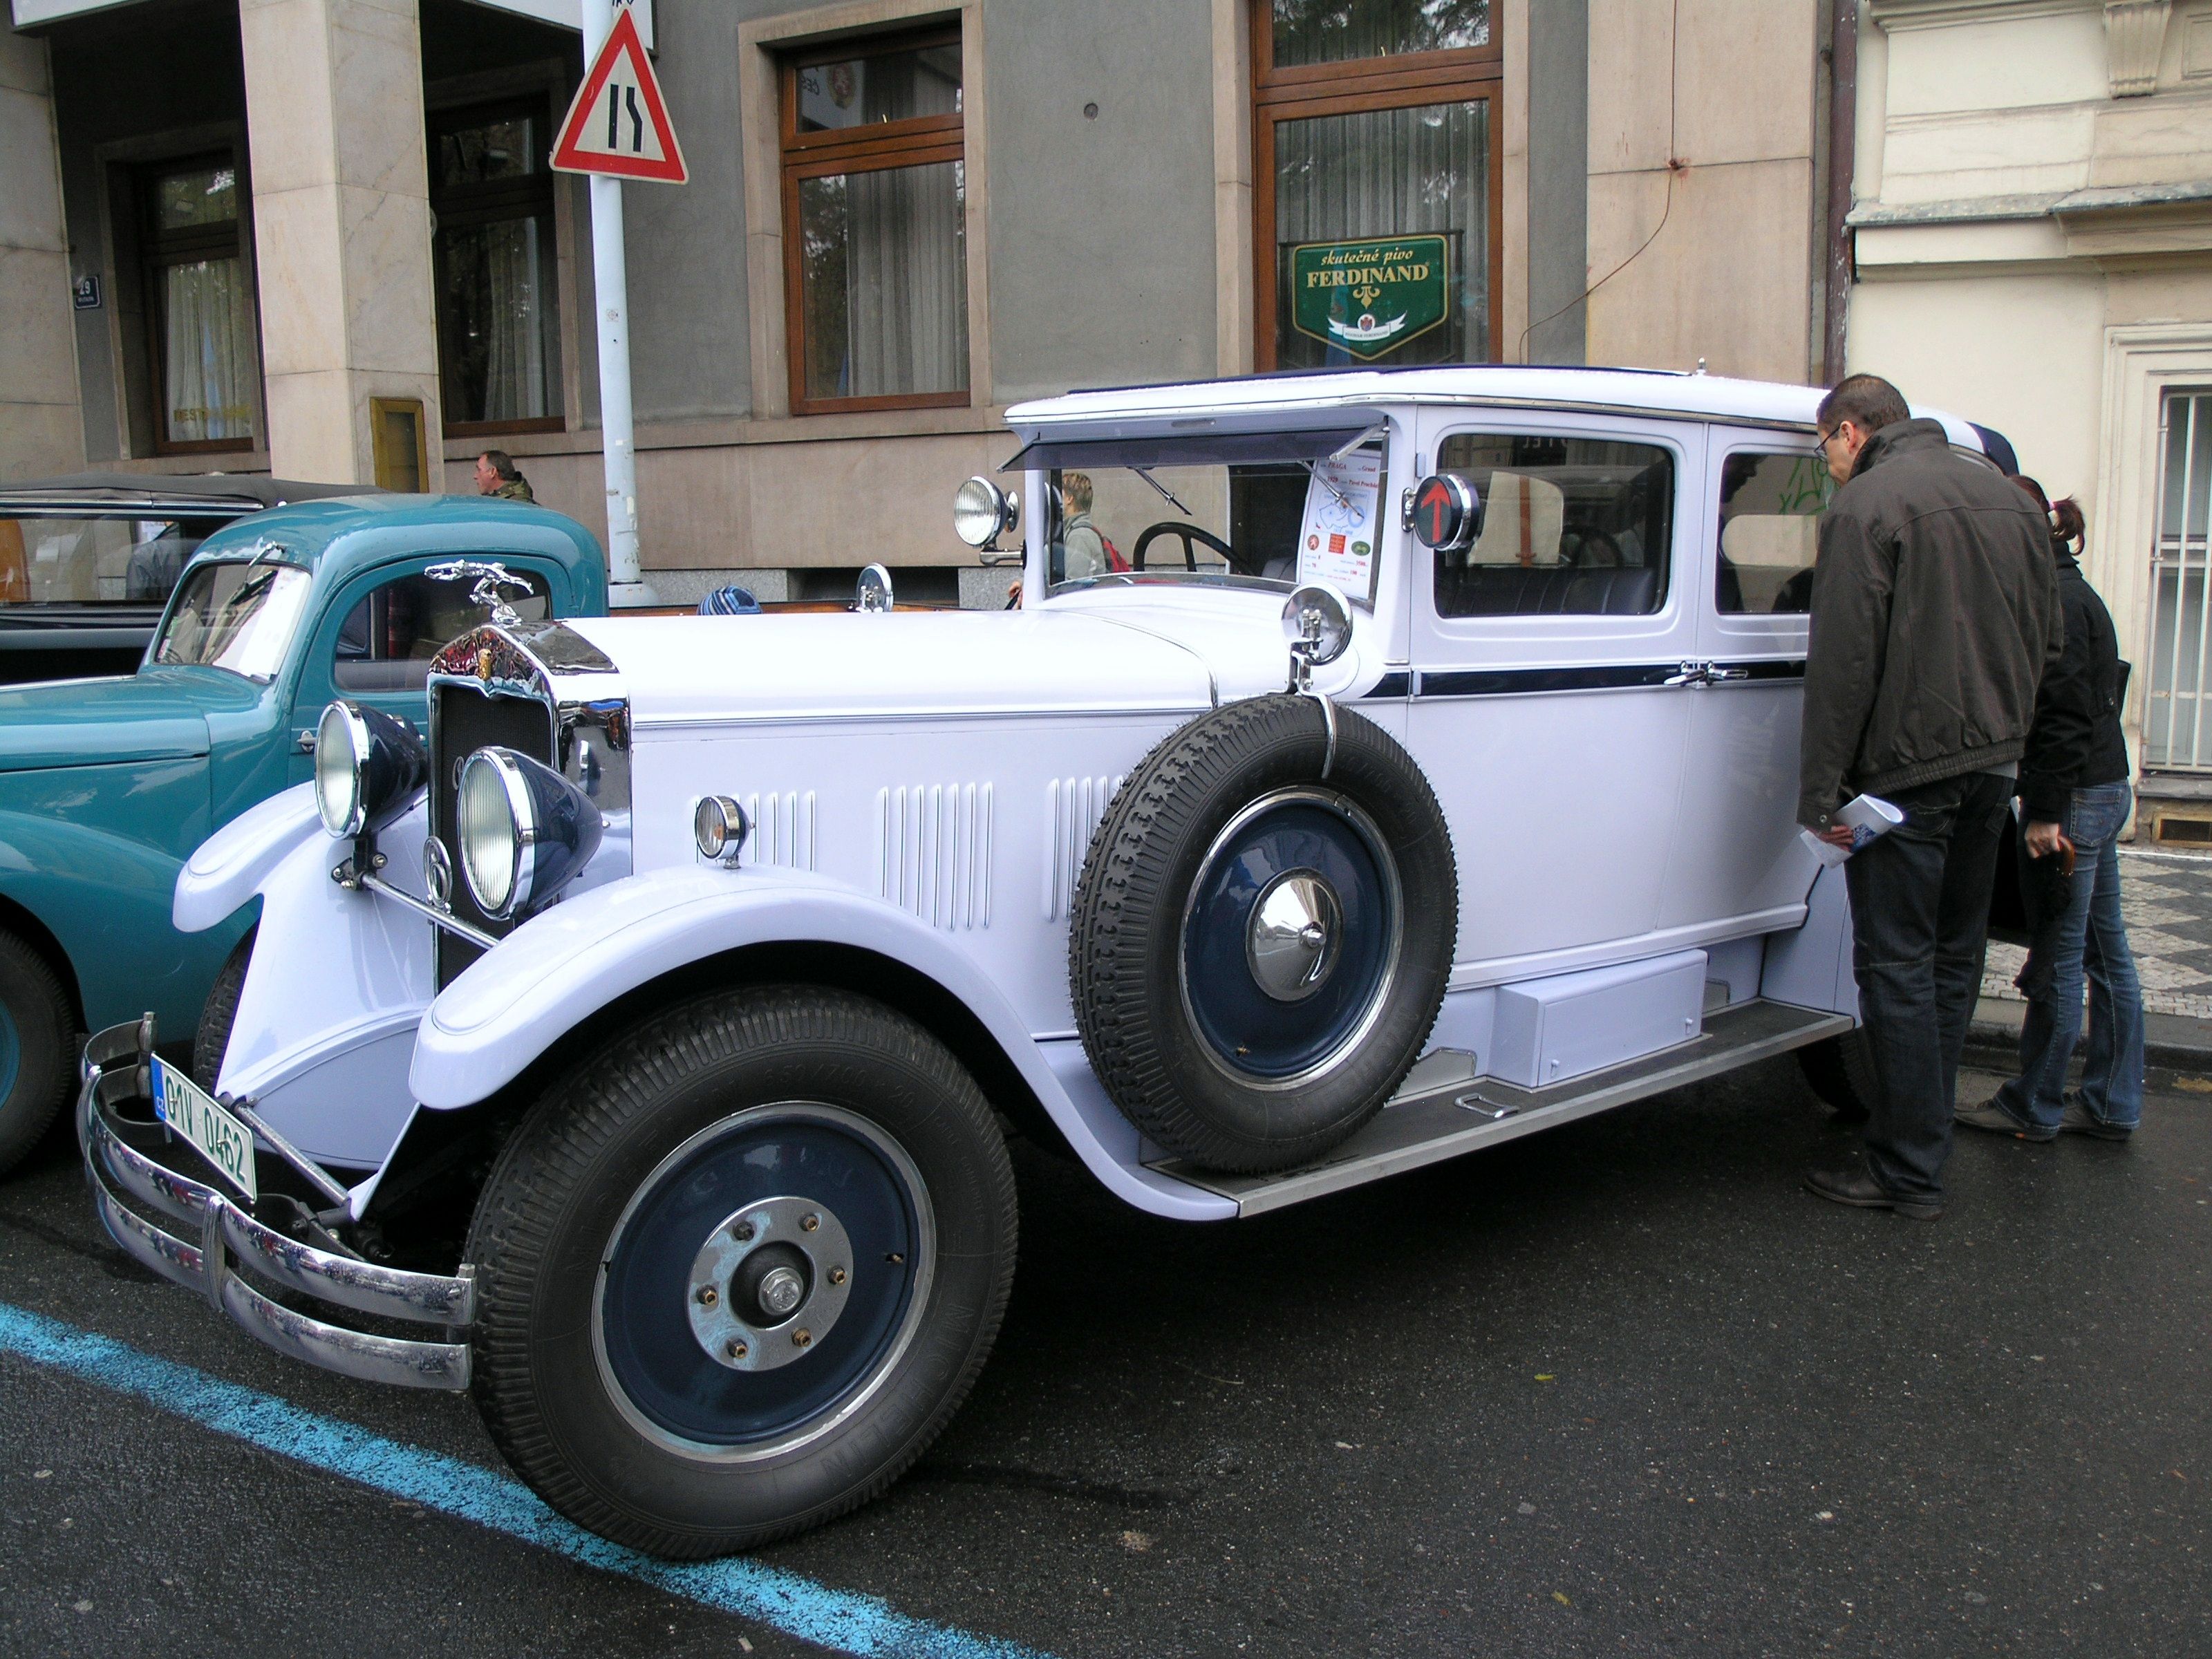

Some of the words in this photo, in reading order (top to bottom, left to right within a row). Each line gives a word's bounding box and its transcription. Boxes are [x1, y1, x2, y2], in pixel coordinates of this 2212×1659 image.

[1320, 248, 1380, 266] skutečné
[1382, 246, 1414, 265] pivo
[1306, 264, 1430, 288] FERDINAND
[156, 1095, 165, 1112] CZ
[165, 1073, 194, 1137] 01V
[204, 1105, 247, 1185] 0462
